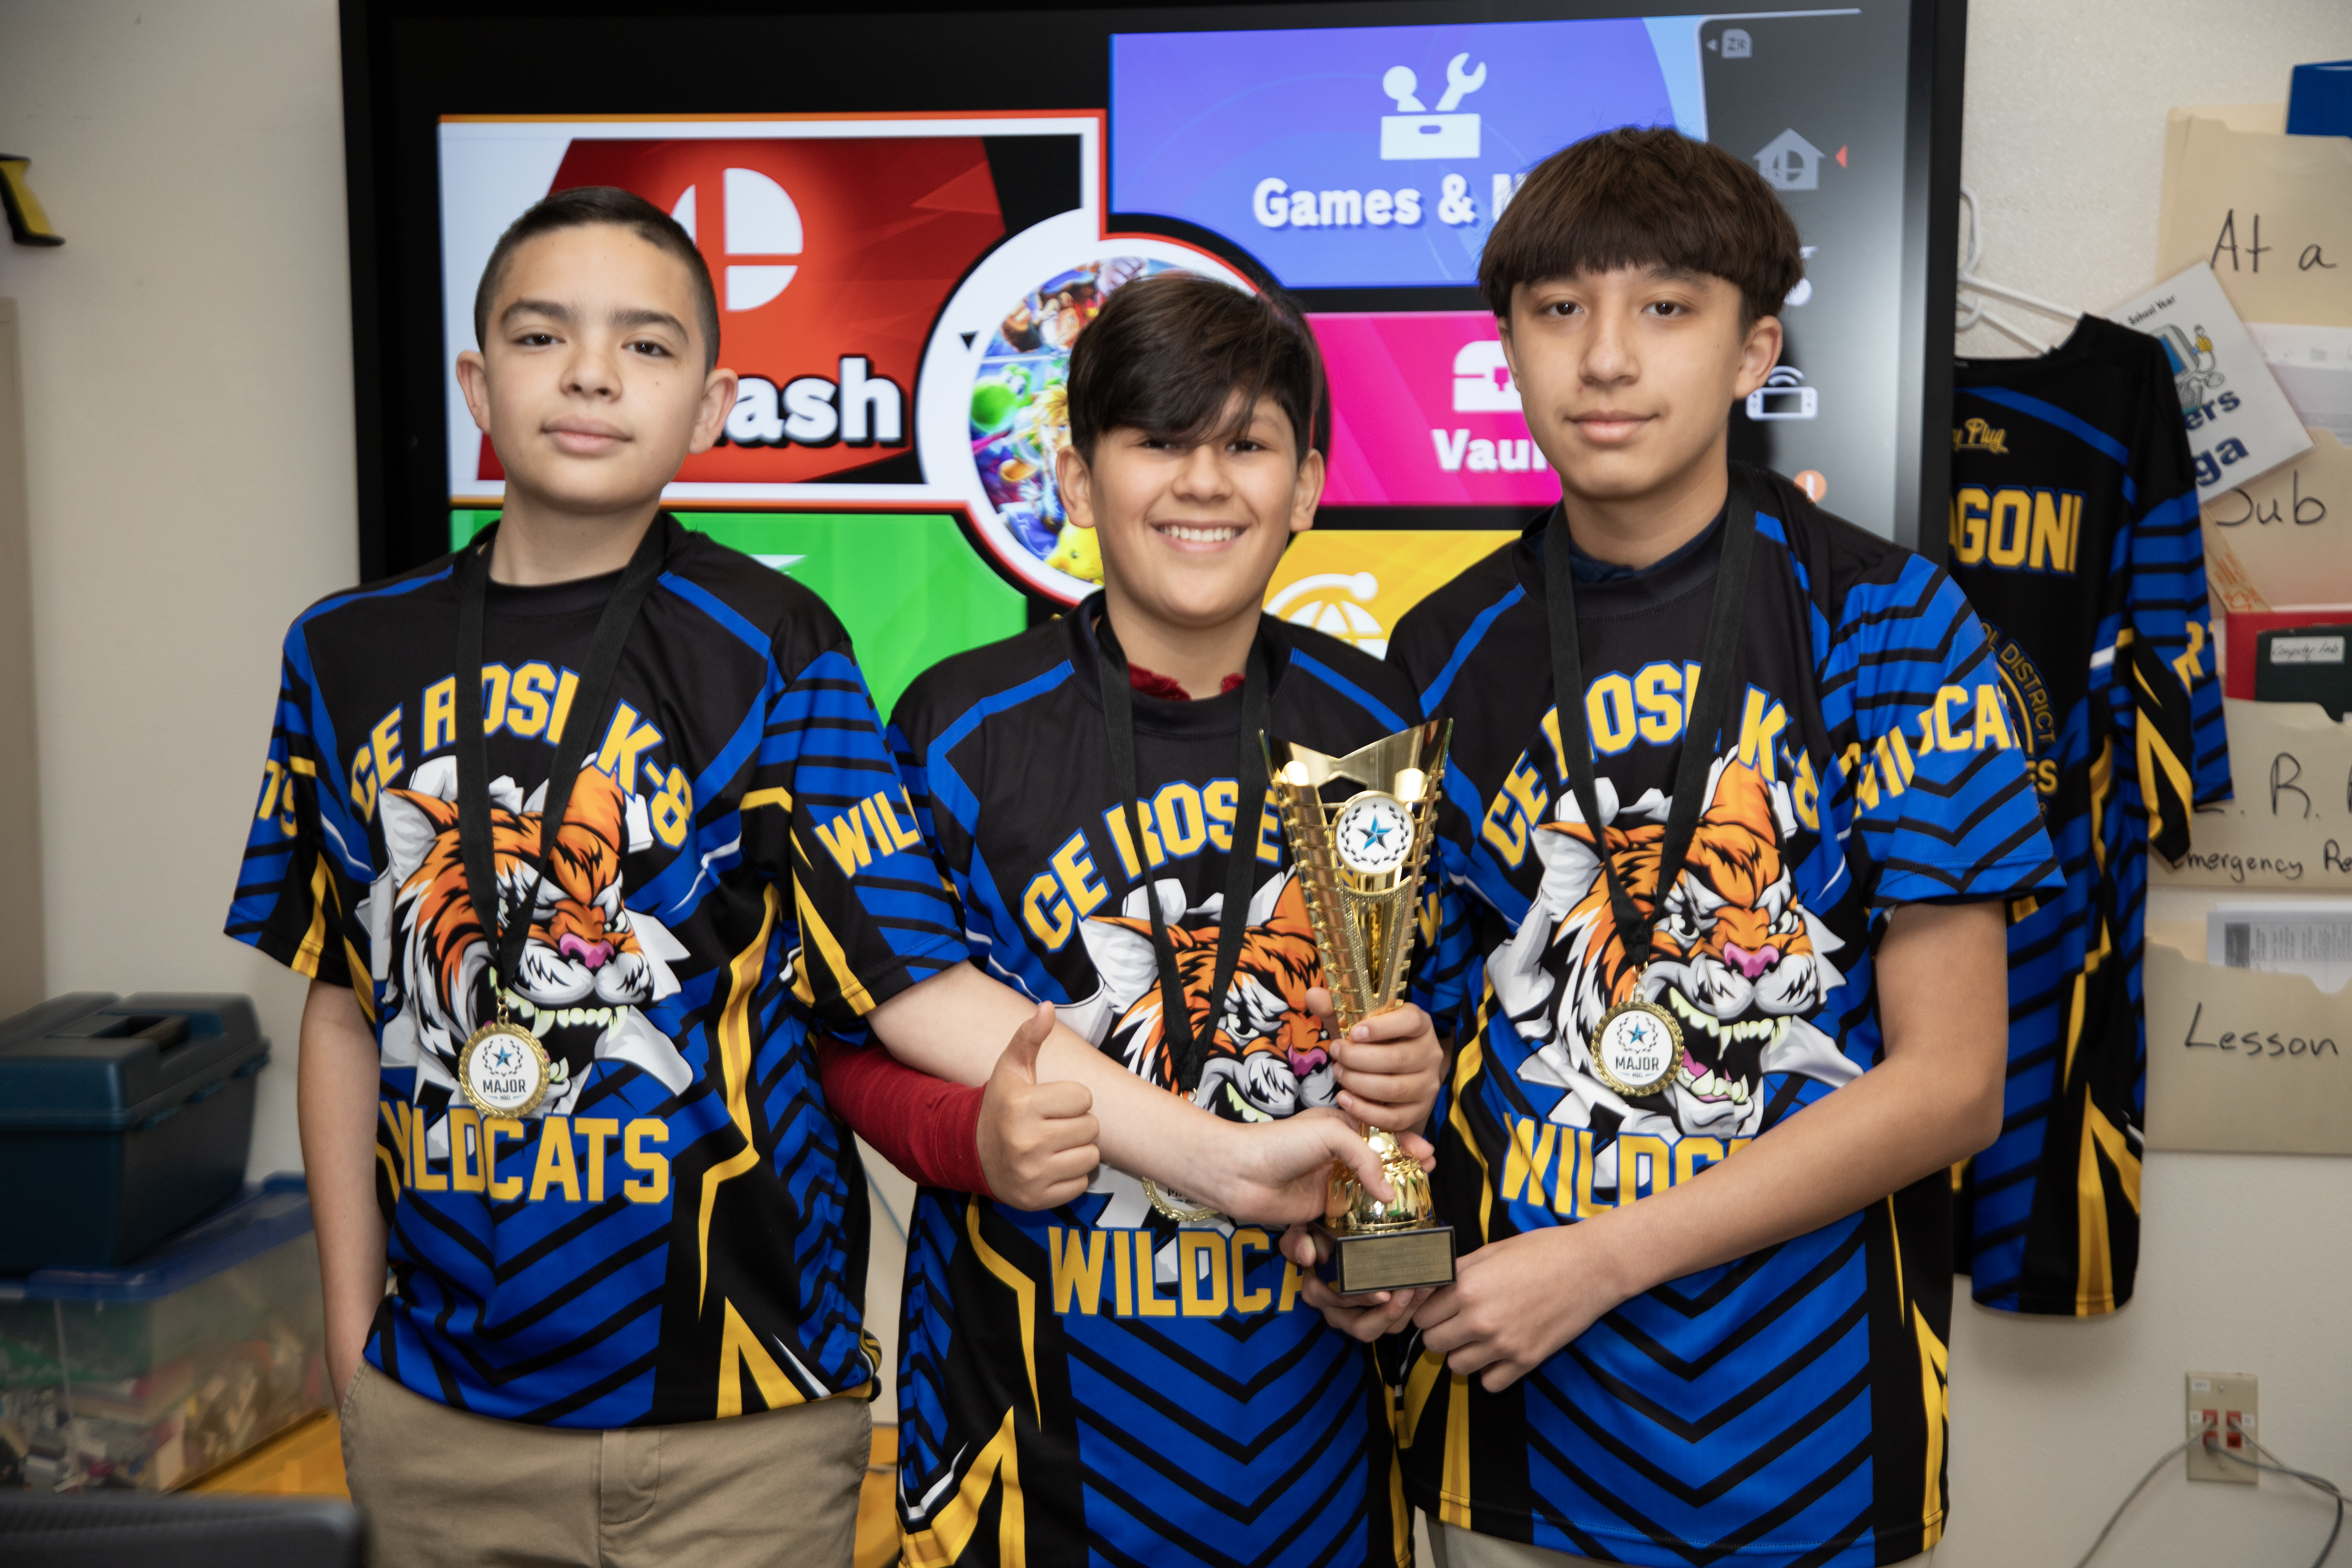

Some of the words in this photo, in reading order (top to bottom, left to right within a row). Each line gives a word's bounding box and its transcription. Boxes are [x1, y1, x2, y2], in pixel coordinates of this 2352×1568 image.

[1254, 177, 1422, 227] Games
[1438, 173, 1476, 225] &
[2211, 209, 2272, 273] At
[2298, 242, 2337, 271] a
[2000, 643, 2056, 744] DISTRICT
[1104, 779, 1280, 880] ROSE
[2177, 853, 2304, 883] mergency
[2184, 1002, 2340, 1056] Lesson
[483, 1078, 526, 1093] MAJOR
[1616, 1055, 1659, 1070] MAJOR
[1502, 1112, 1752, 1218] WILDC
